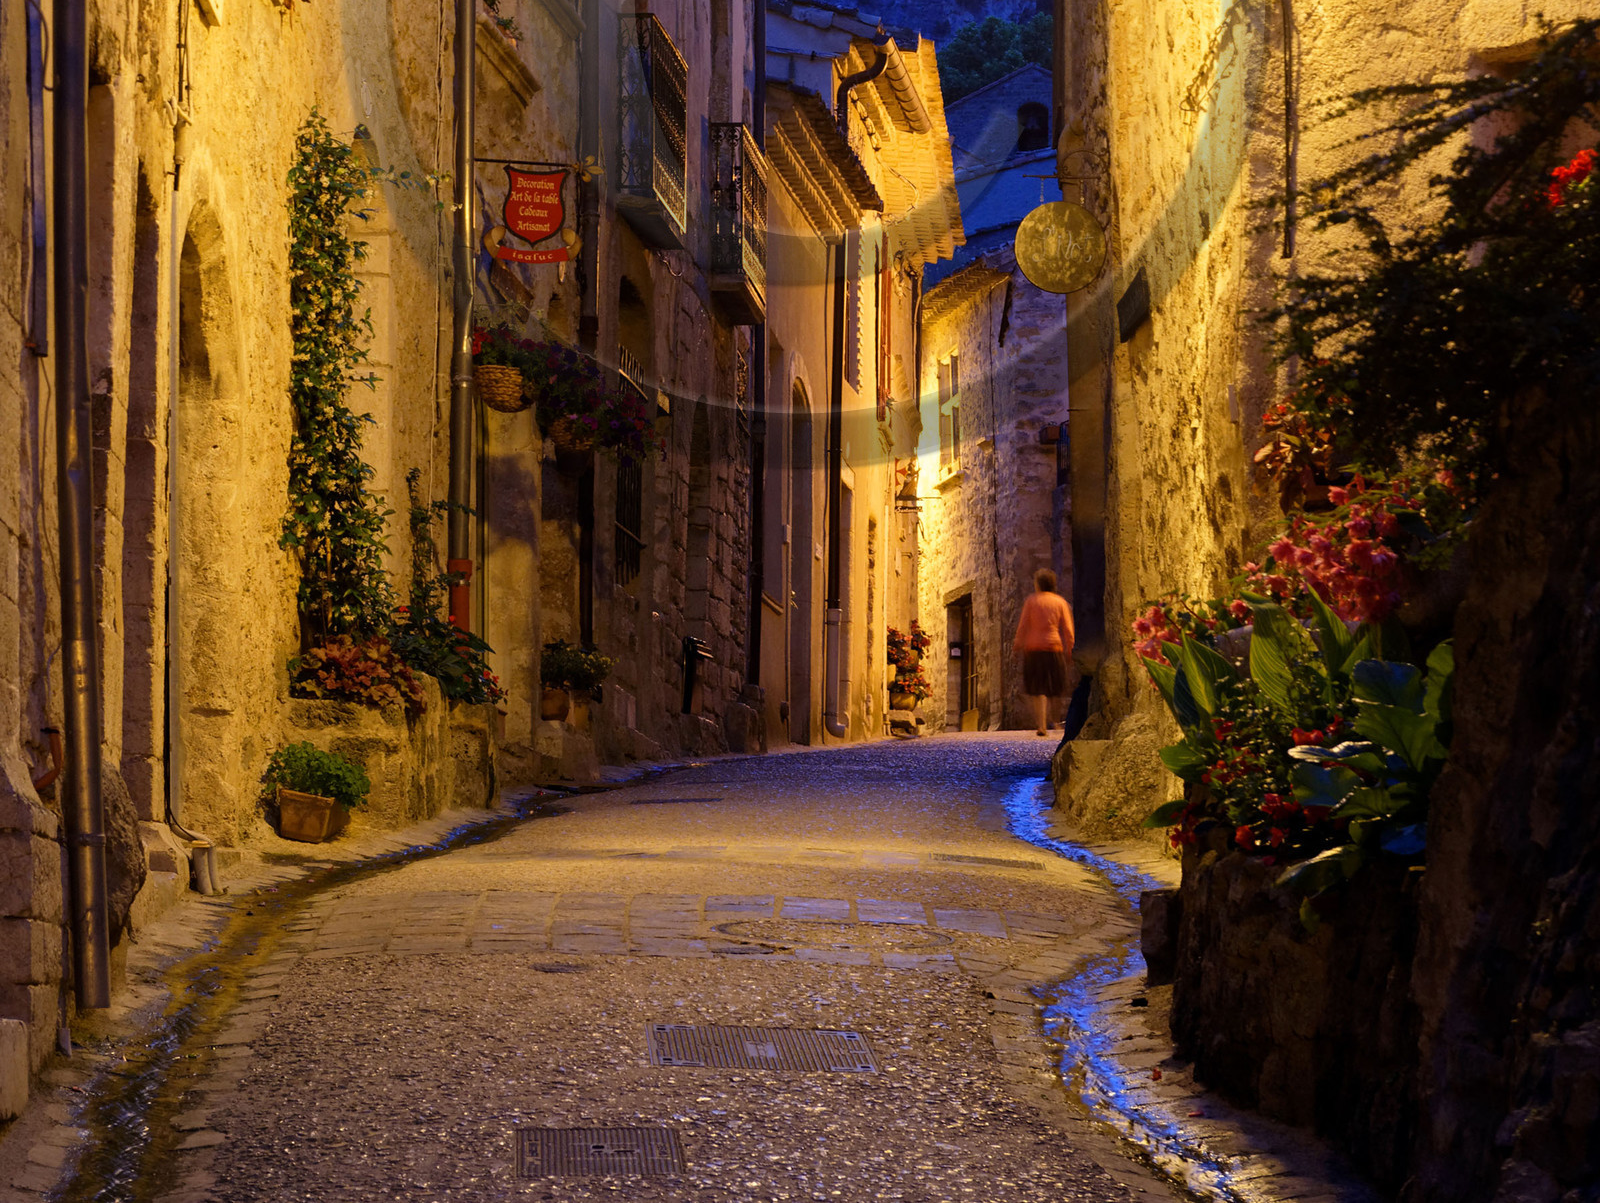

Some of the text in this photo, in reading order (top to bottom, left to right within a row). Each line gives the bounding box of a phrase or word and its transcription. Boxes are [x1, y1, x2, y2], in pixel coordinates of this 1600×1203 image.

[510, 190, 559, 204] Art de la table
[519, 205, 549, 217] Cadeaux
[516, 220, 550, 232] Artisanat
